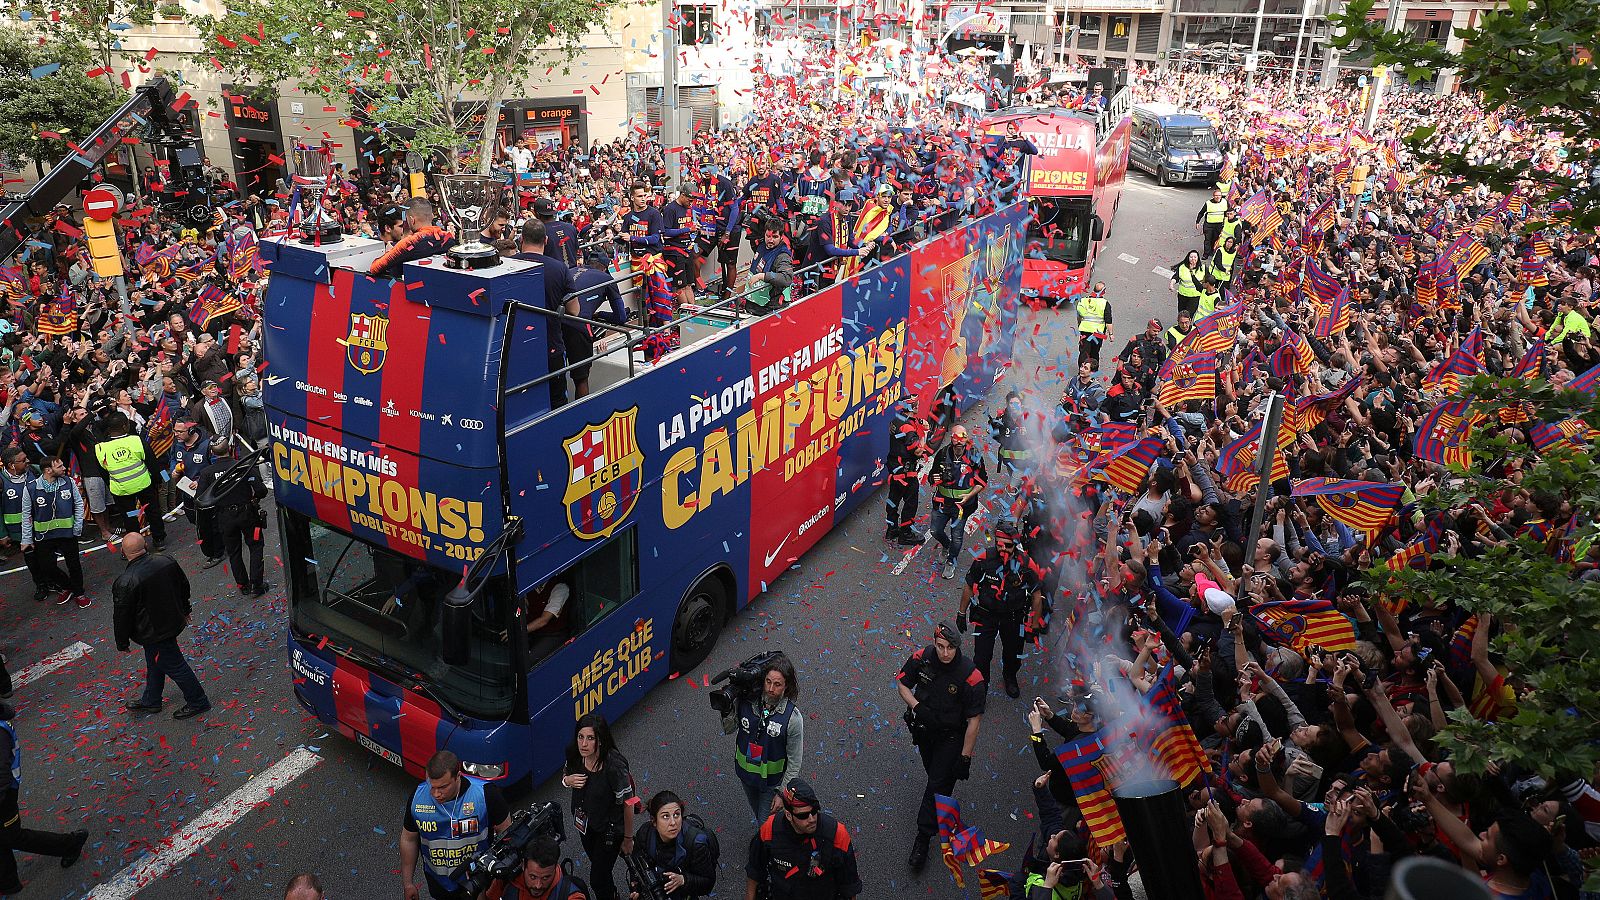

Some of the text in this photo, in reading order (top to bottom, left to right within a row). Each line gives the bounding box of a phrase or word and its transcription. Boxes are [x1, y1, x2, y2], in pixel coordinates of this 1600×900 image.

[471, 113, 505, 122] orae
[541, 108, 572, 118] orange
[1030, 170, 1088, 185] PIONS!
[334, 390, 348, 400] beko
[658, 324, 844, 451] LA PILOTA ENS FA MÉS
[410, 409, 435, 421] KONAMI
[661, 321, 906, 530] CAMPIONS!
[784, 428, 838, 483] DOBLET
[838, 411, 866, 442] 2017
[876, 380, 902, 416] 2018
[116, 449, 127, 458] BP
[270, 422, 398, 477] LA PILOTA ENS FA MÉS
[273, 441, 485, 543] CAMPIONS!
[590, 463, 621, 491] FCB
[350, 509, 398, 538] DOBLET
[400, 528, 431, 550] 2017
[571, 617, 654, 699] MÉS QUE
[575, 646, 652, 722] UN CLUB
[430, 843, 479, 859] EGURETAT
